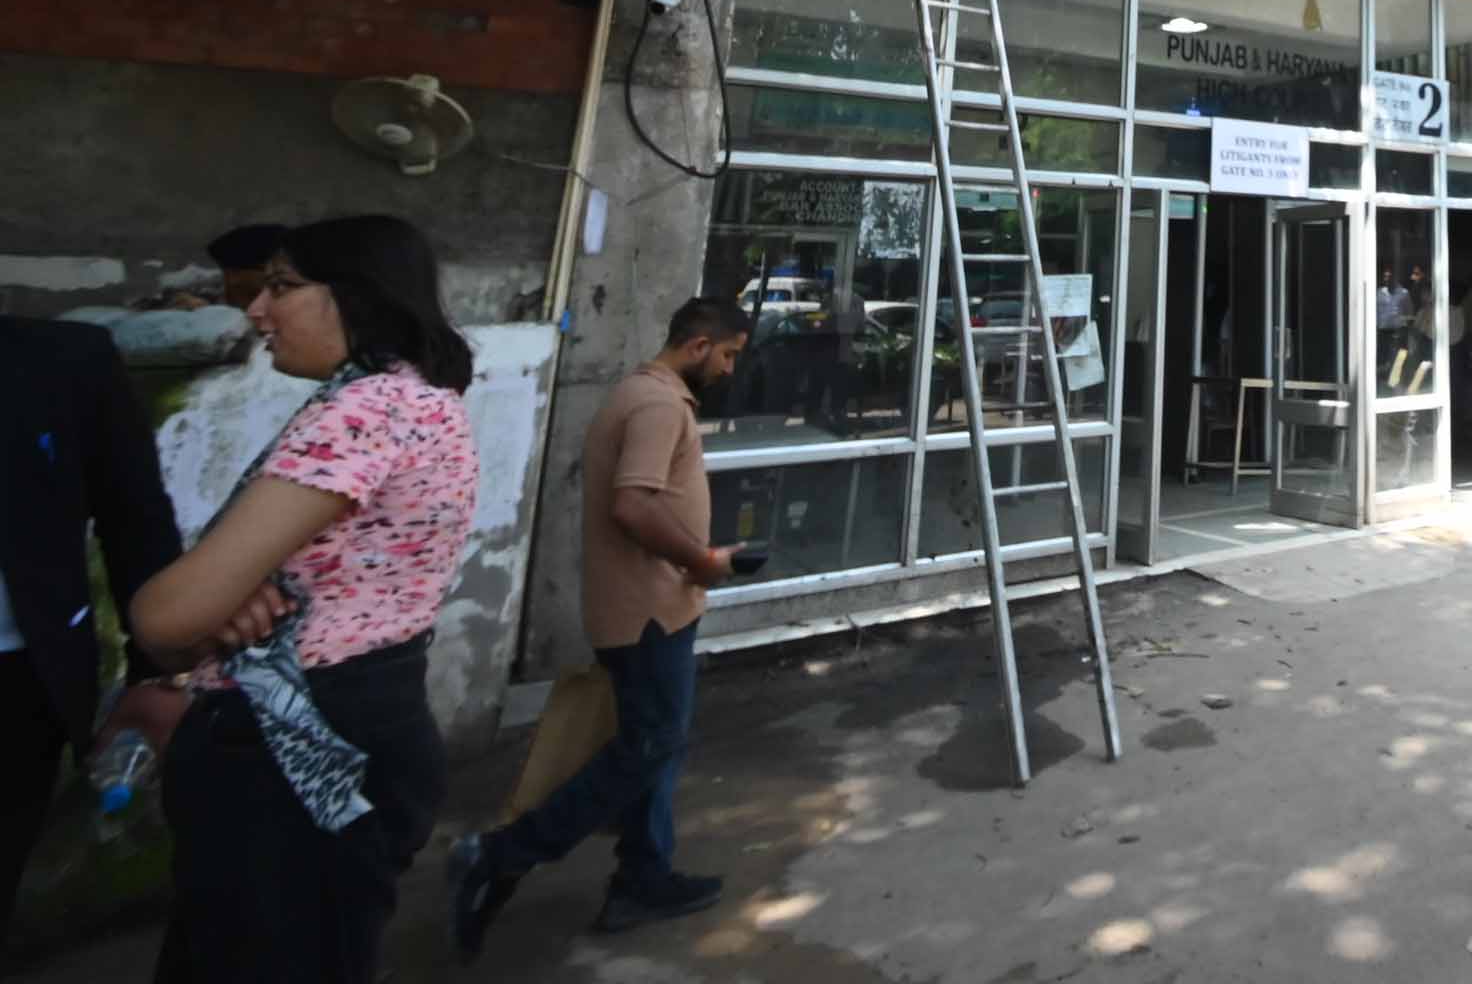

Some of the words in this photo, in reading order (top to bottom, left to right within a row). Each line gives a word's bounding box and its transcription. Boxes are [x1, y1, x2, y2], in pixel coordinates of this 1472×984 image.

[1167, 34, 1248, 70] PUNJAB
[1253, 48, 1264, 72] &
[1418, 82, 1443, 137] 2
[1221, 165, 1246, 177] GATE
